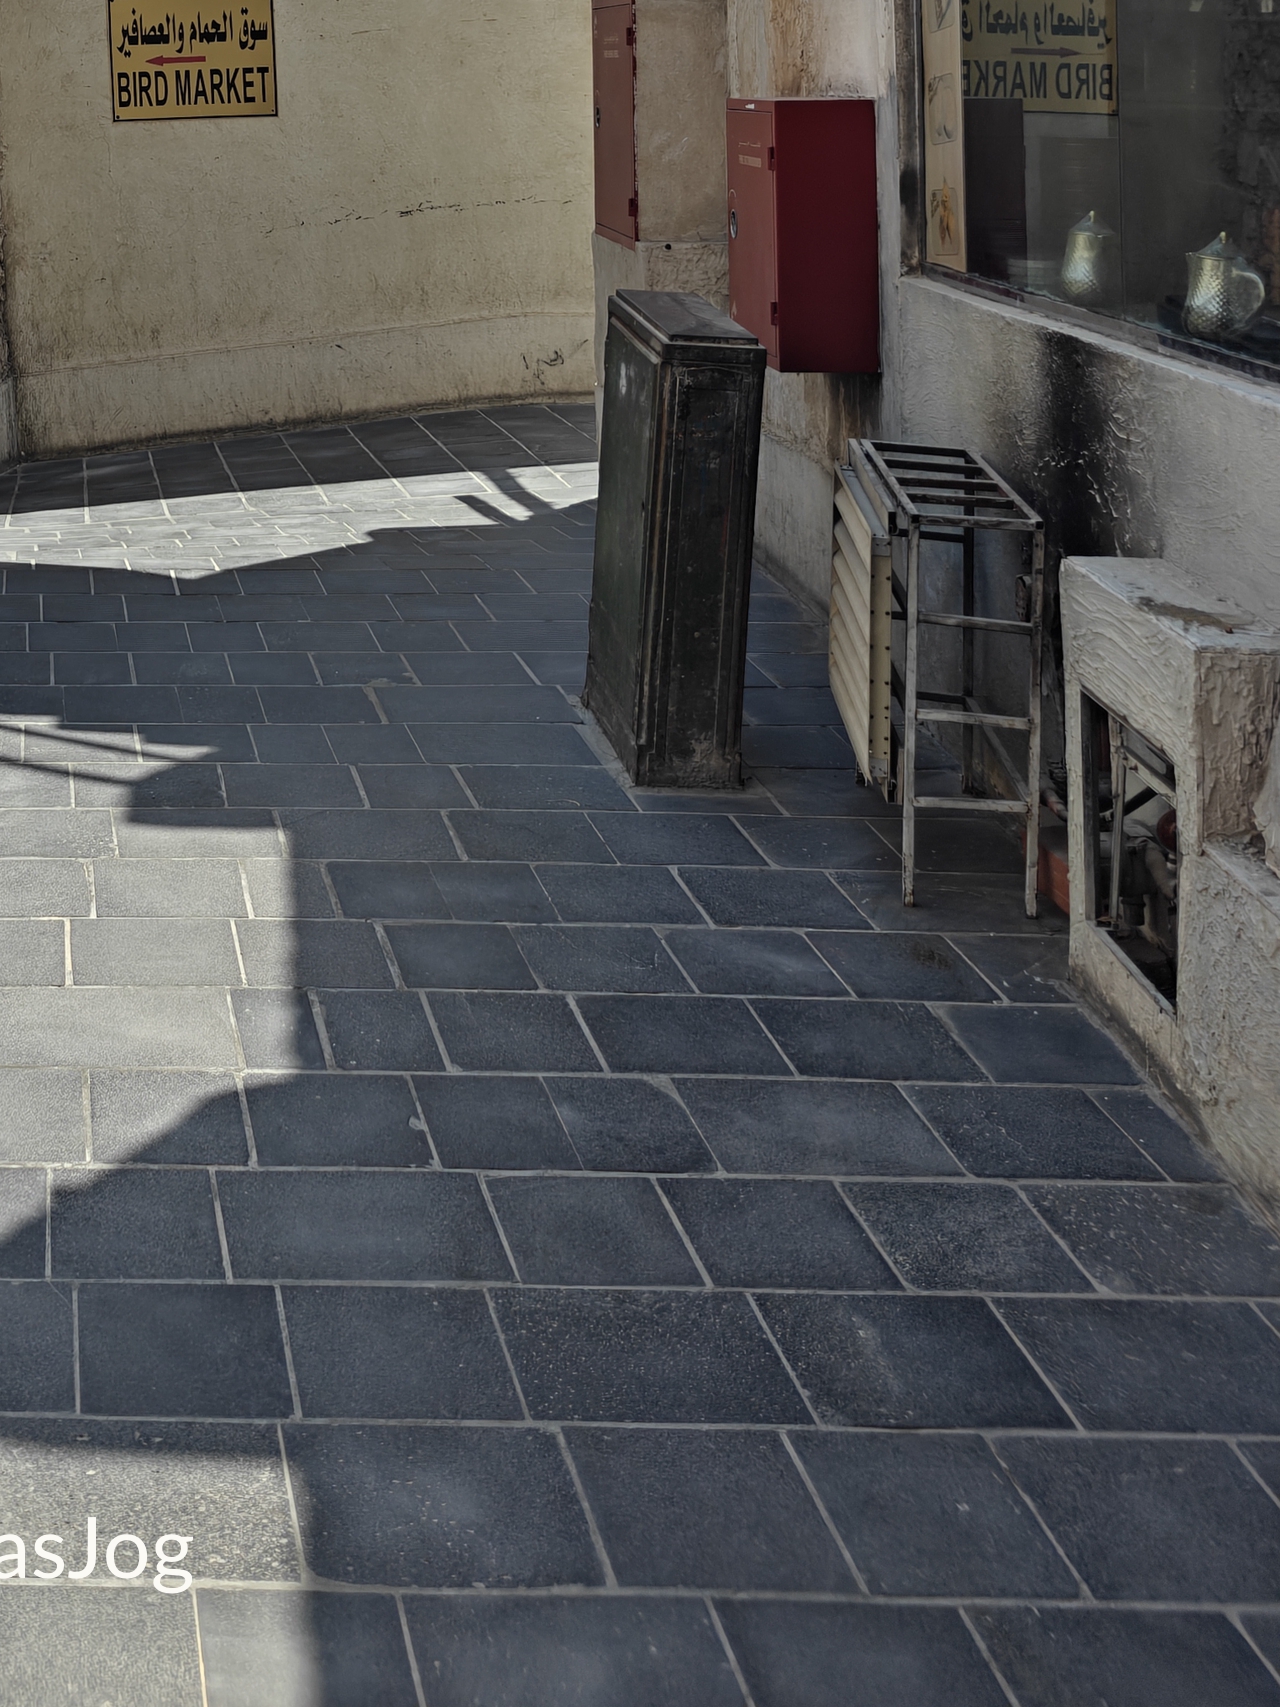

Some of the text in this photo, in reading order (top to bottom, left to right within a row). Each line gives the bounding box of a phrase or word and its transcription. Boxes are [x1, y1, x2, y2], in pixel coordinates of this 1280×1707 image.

[116, 7, 268, 58] سوق الحمام والعصافير
[117, 67, 269, 107] BIRD MARKET
